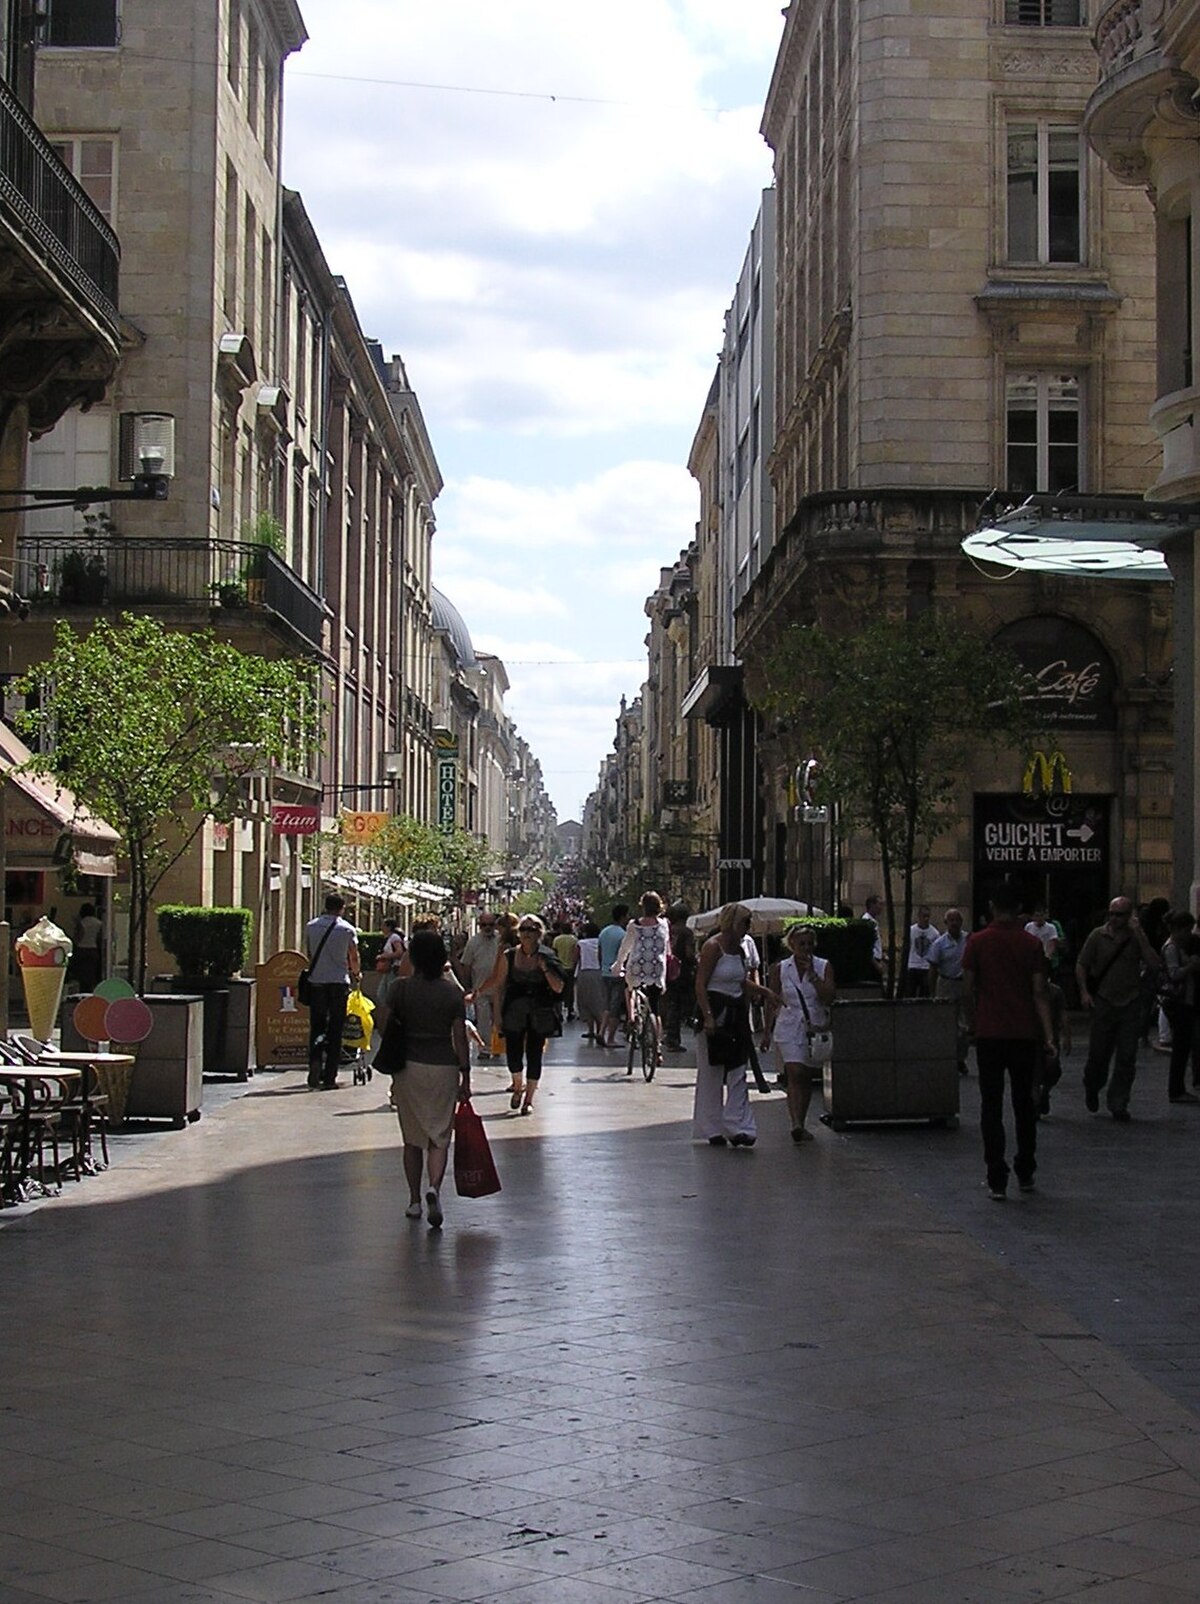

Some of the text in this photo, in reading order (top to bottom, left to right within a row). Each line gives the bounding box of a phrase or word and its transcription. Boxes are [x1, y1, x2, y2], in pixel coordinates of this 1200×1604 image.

[441, 766, 455, 833] HOTEL
[6, 818, 53, 836] NCE
[272, 810, 317, 828] Etam
[984, 822, 1064, 847] GUICHET
[986, 847, 1023, 861] VENTE
[1040, 847, 1101, 862] EMPORTER
